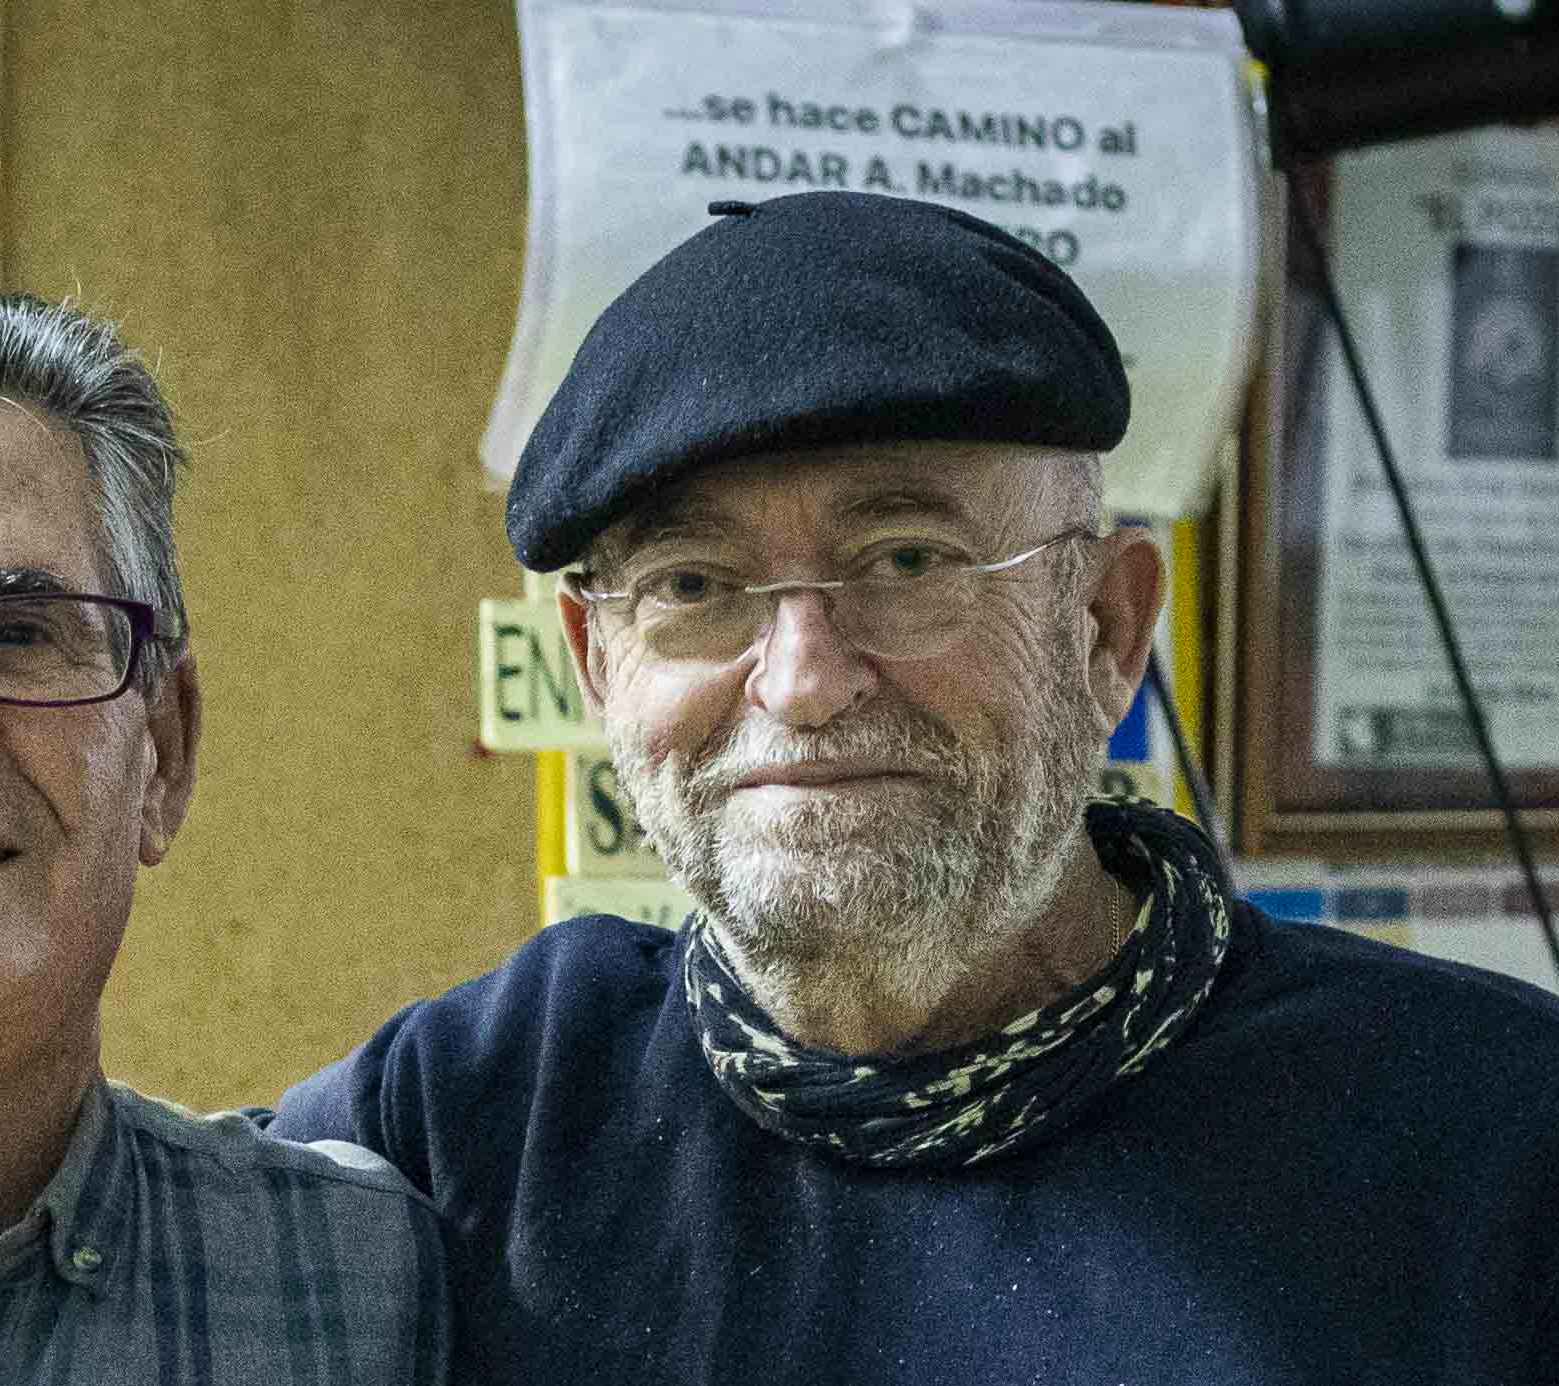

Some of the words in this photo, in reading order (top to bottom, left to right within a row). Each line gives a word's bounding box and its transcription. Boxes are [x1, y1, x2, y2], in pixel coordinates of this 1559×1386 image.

[767, 92, 879, 133] hace
[889, 102, 1084, 152] CAMINO
[1098, 123, 1137, 156] al
[683, 140, 849, 187] ANDAR
[917, 159, 1126, 213] Machado
